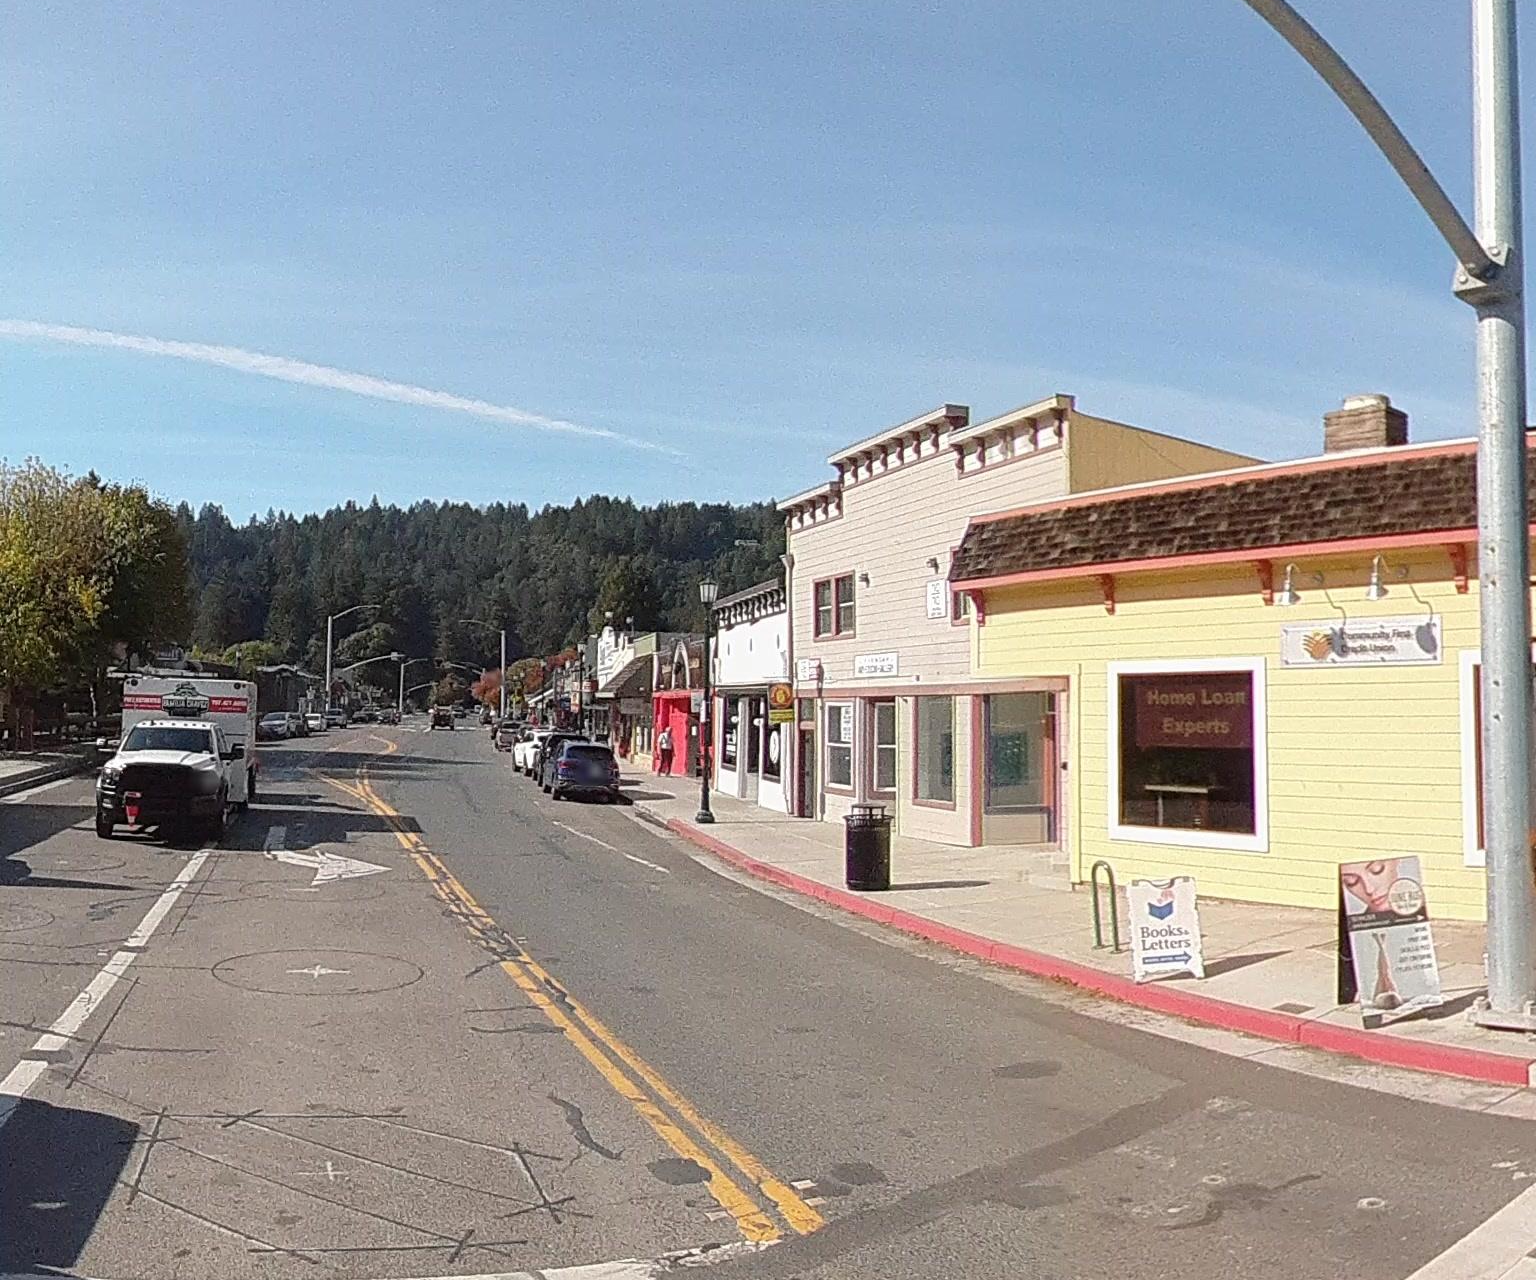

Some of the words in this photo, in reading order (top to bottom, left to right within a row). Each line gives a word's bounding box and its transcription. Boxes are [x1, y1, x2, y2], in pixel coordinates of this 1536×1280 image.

[1340, 628, 1390, 641] Community
[1369, 642, 1396, 653] Union
[1148, 689, 1197, 707] Home
[1200, 685, 1246, 706] Loan
[1161, 717, 1232, 738] Experts
[1140, 924, 1183, 939] Books
[1141, 938, 1192, 952] Letters
